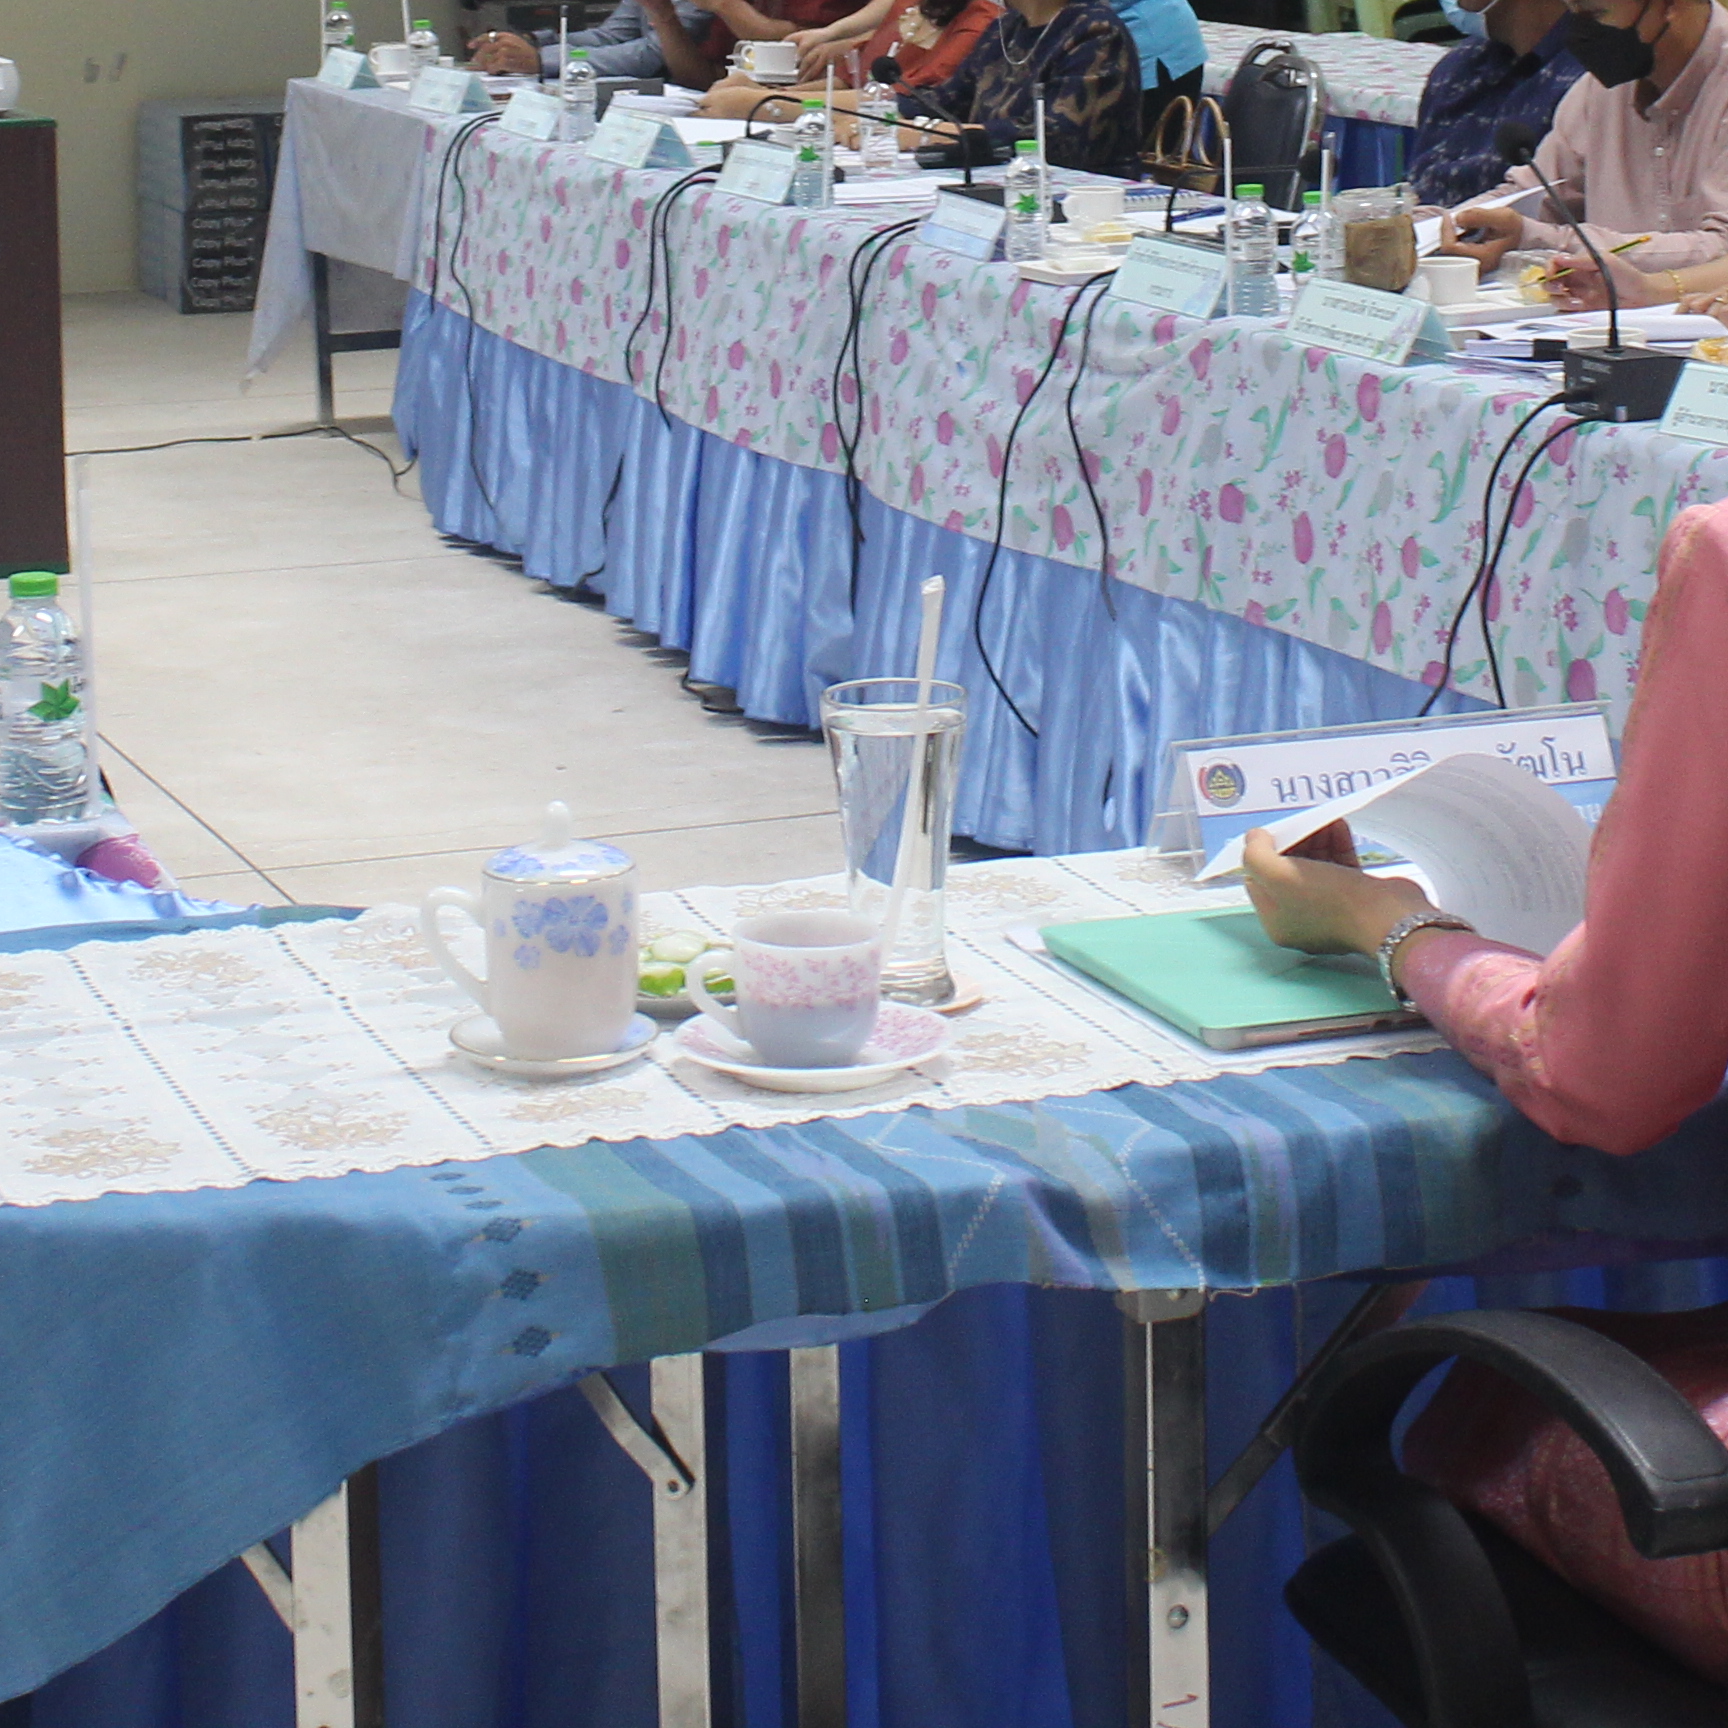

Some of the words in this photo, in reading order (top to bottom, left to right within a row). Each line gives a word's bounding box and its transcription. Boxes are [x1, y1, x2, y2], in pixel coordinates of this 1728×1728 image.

[193, 218, 221, 229] Copy
[193, 238, 221, 249] Copy
[193, 258, 221, 269] Copy
[192, 277, 220, 288] Copy
